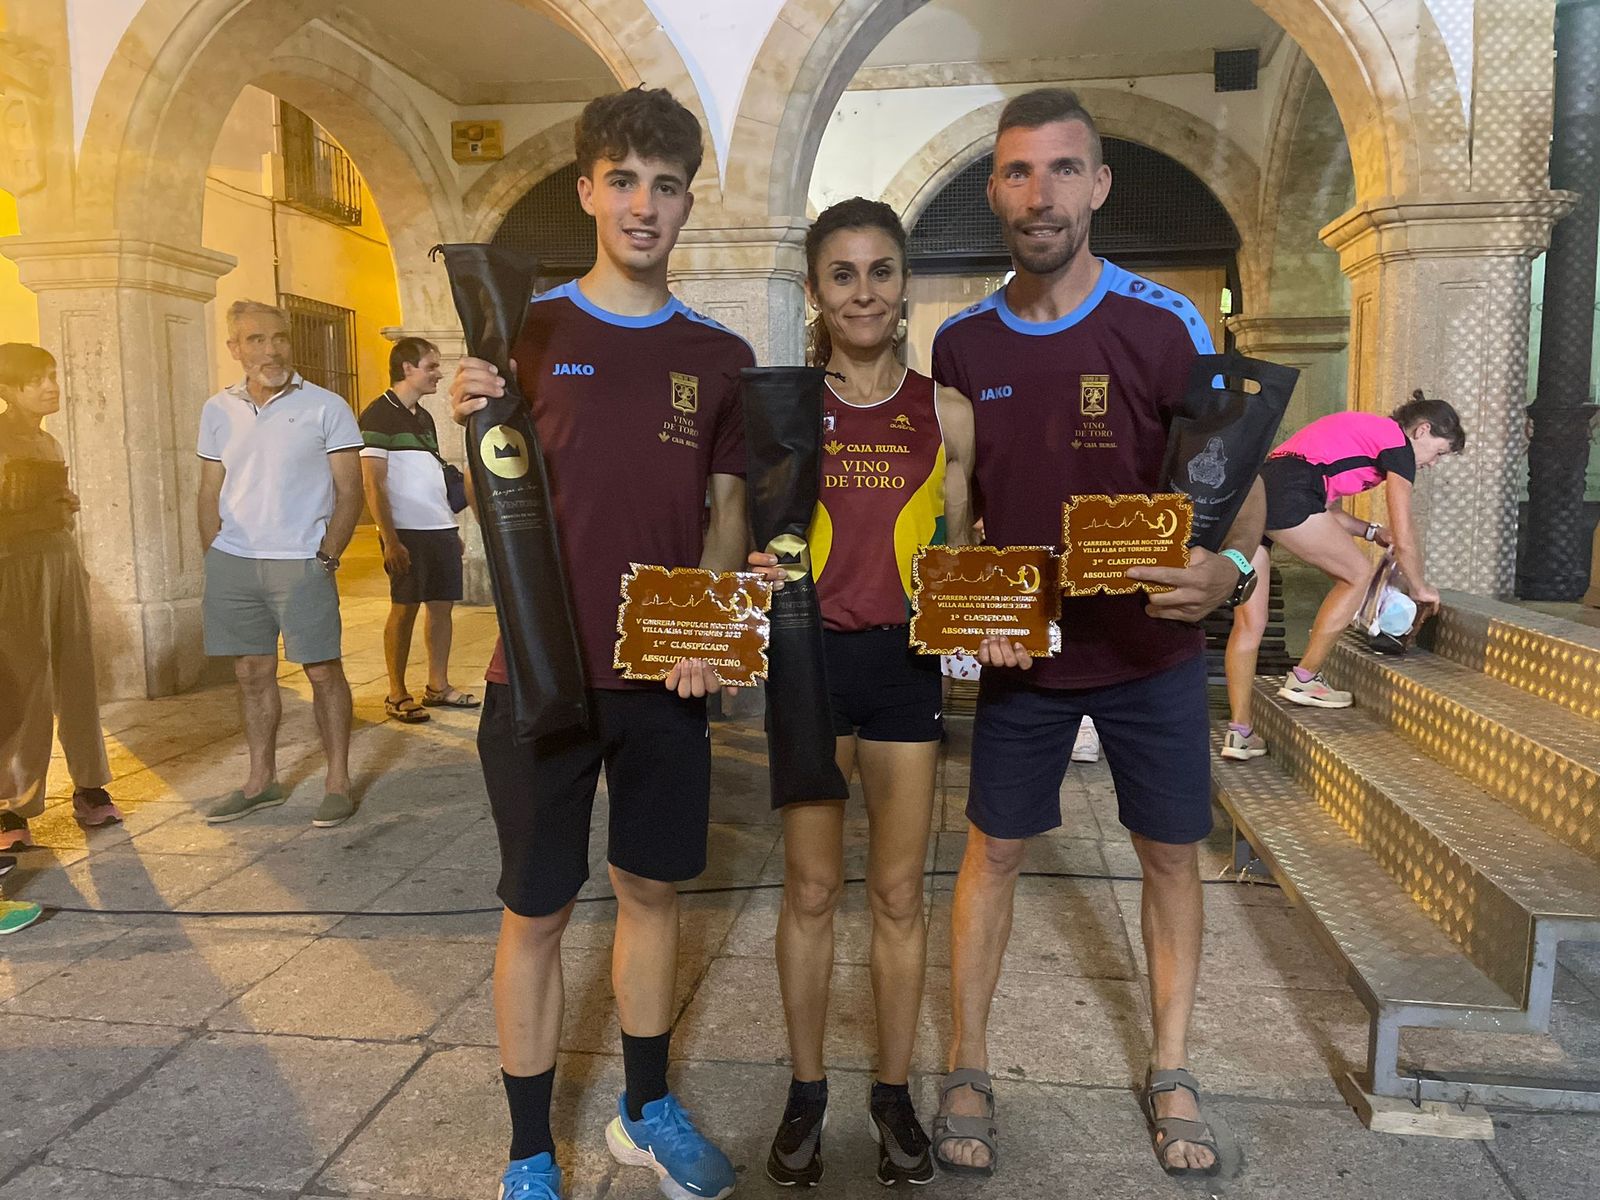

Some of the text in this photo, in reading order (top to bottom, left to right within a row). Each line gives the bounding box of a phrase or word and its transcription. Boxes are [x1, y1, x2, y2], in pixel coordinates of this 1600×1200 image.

[552, 364, 595, 376] JAKO
[980, 385, 1012, 401] JAKO
[674, 416, 694, 426] VINO
[664, 422, 698, 436] DE TORO
[846, 444, 910, 453] CAJA RURAL
[841, 460, 890, 473] VINO
[825, 475, 905, 489] DE TORO
[670, 641, 729, 651] CLASIFICADO
[690, 657, 740, 667] CULINO
